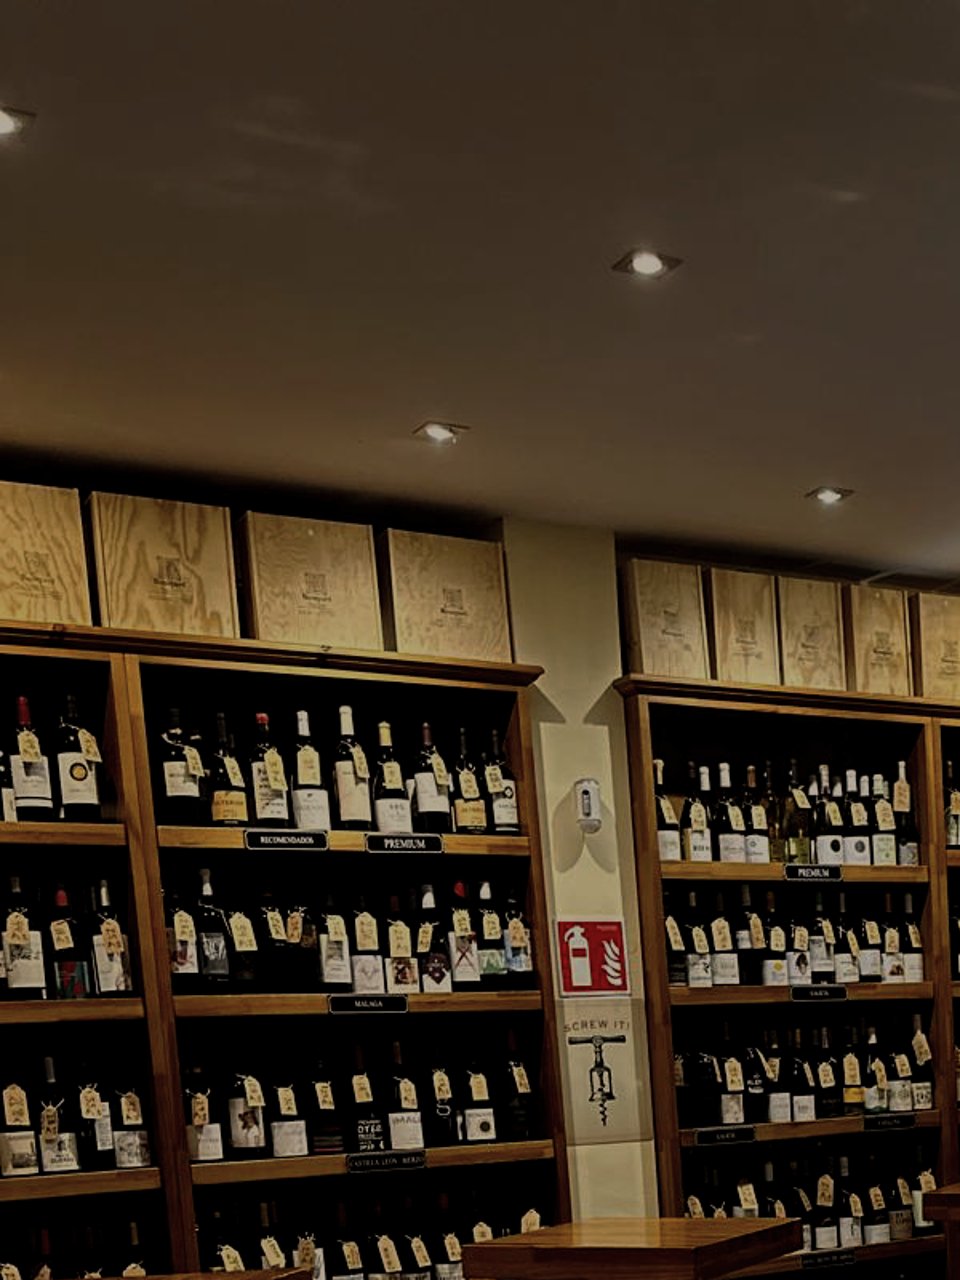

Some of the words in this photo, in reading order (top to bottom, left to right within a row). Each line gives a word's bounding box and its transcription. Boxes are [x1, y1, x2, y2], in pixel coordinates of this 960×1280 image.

[384, 838, 426, 849] PREMIUM
[798, 867, 830, 877] PREMIUM
[563, 1019, 608, 1033] SCREW
